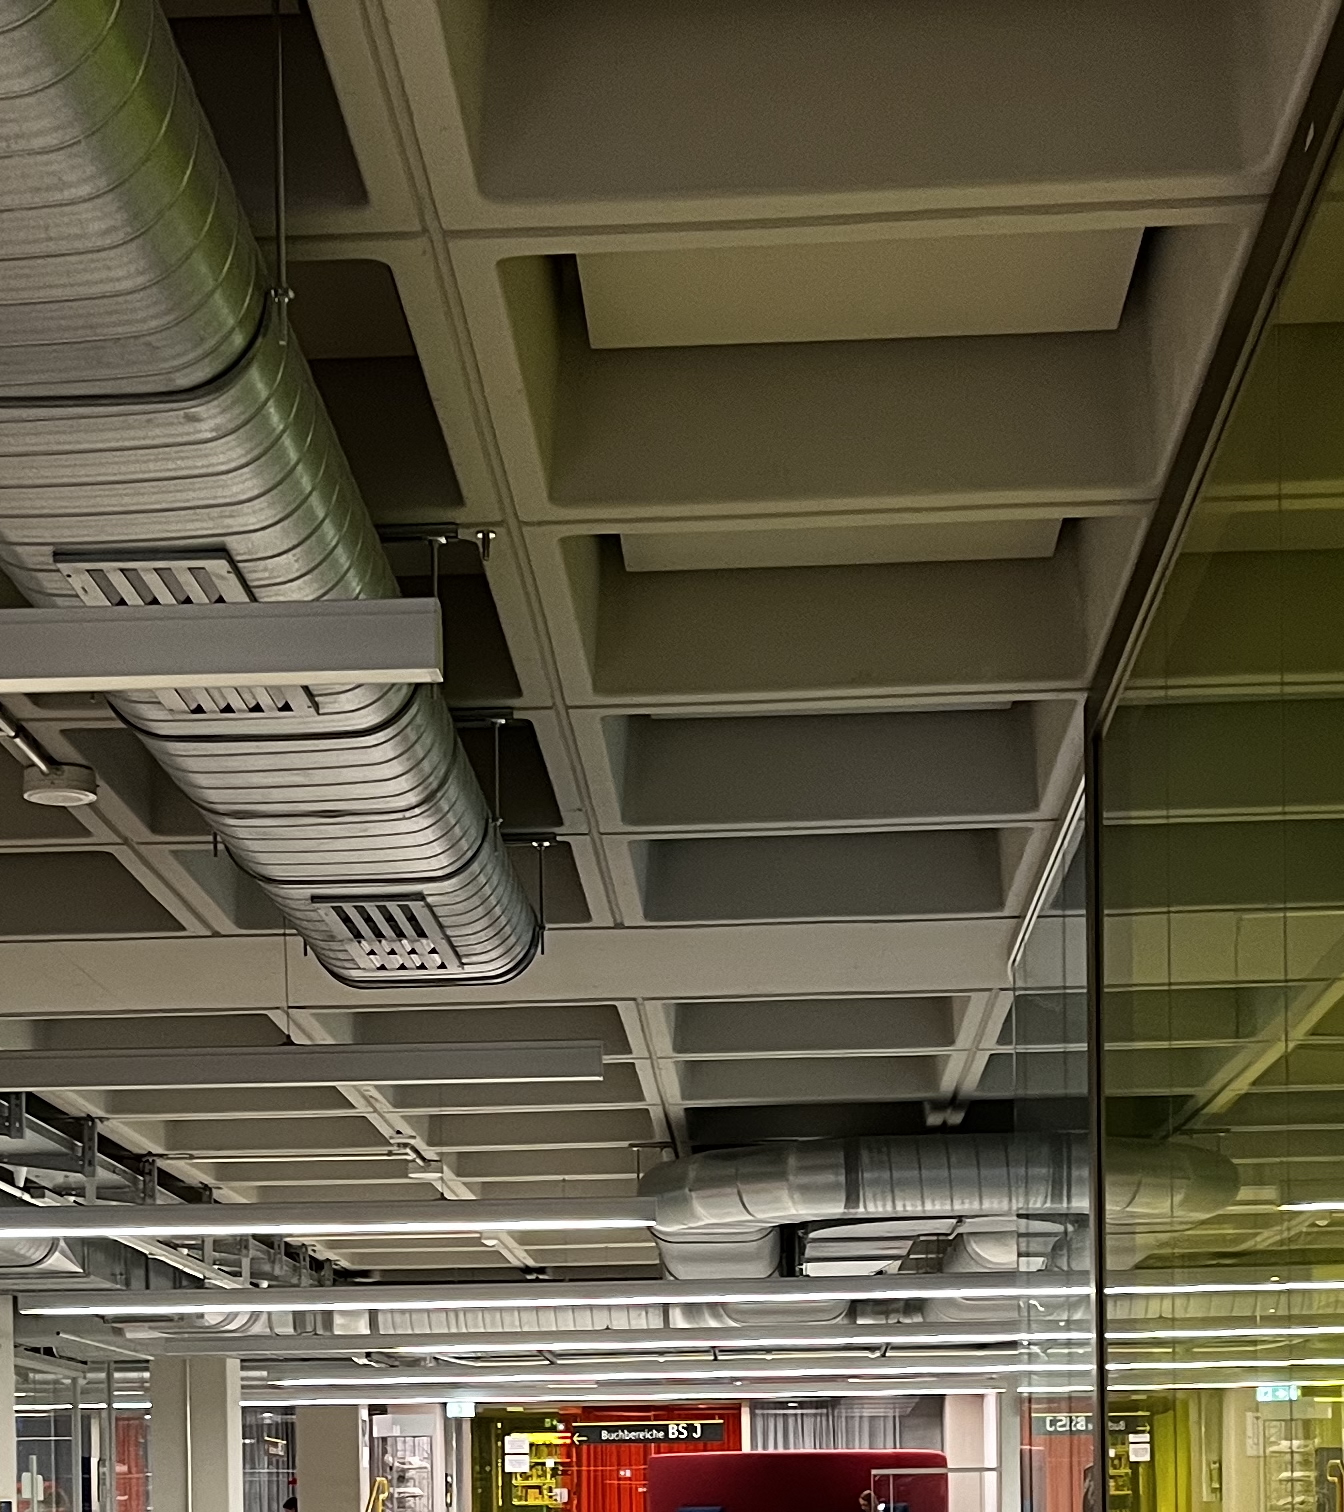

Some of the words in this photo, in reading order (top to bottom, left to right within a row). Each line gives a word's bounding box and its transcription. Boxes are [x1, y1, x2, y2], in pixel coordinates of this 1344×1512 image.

[601, 1429, 665, 1440] Buchbereiche
[668, 1423, 688, 1438] BS
[692, 1423, 702, 1438] J
